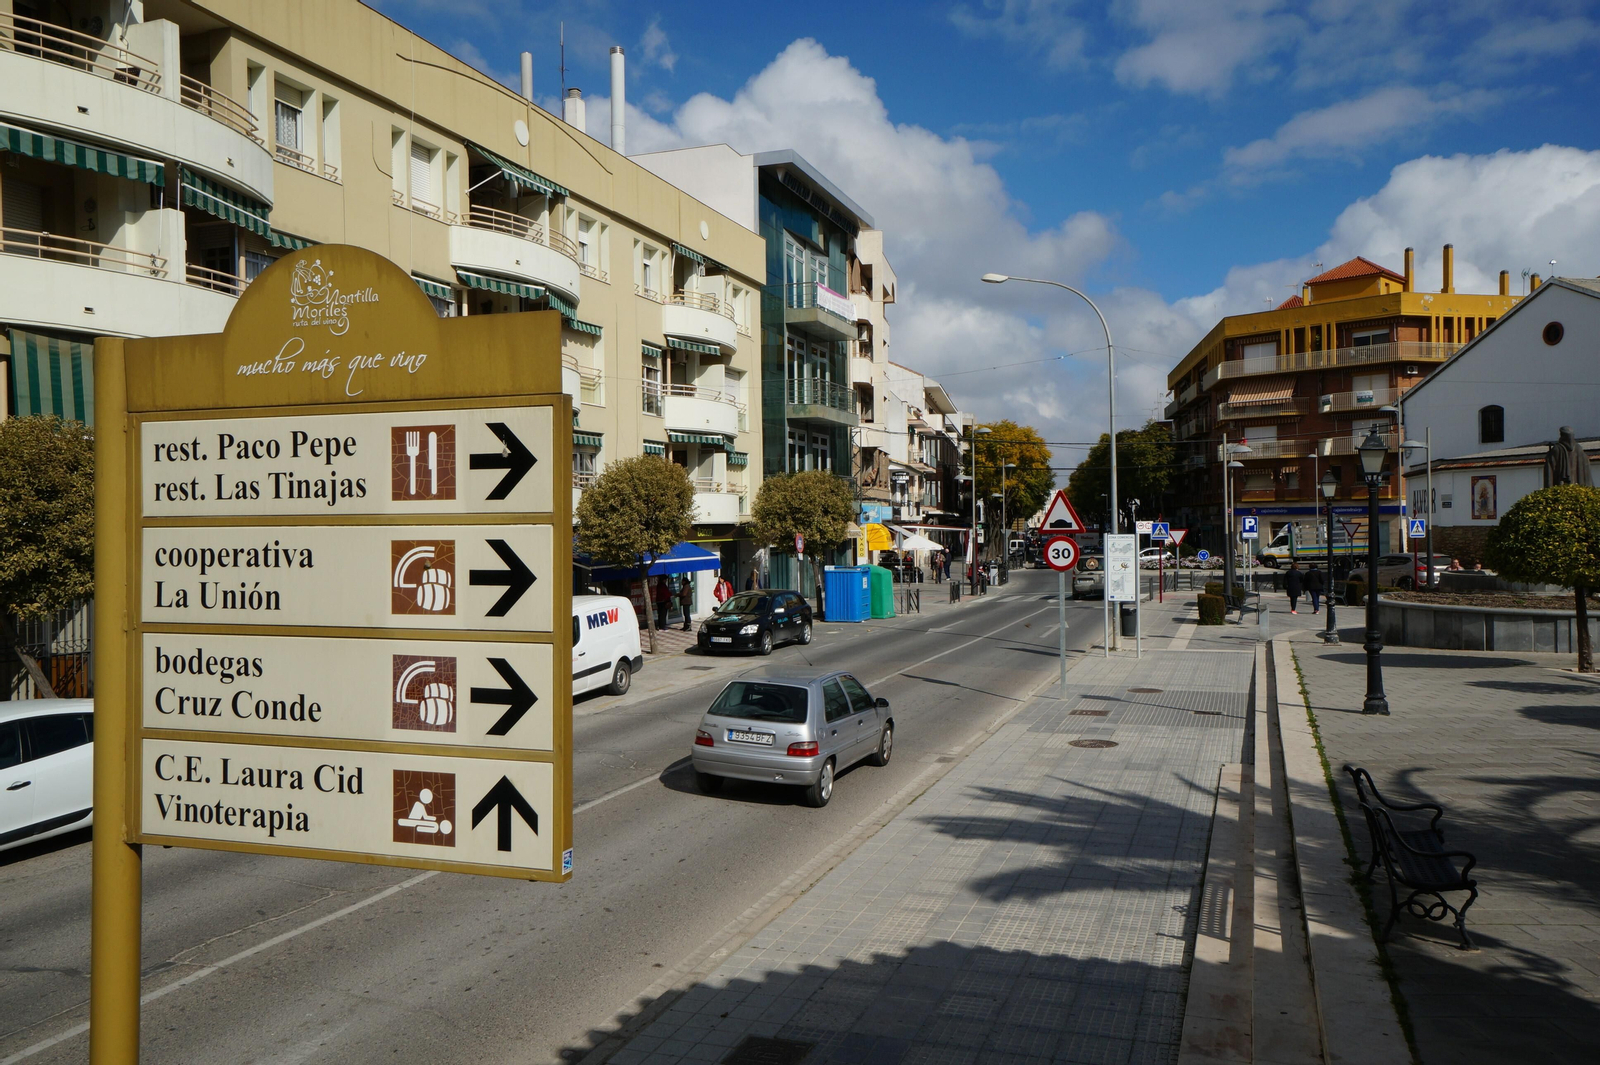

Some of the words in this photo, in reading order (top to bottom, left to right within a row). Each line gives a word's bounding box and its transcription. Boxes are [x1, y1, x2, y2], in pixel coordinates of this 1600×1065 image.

[325, 287, 380, 306] Montilla
[291, 302, 349, 326] Moriles
[292, 319, 308, 327] ruta
[310, 317, 321, 326] del
[236, 336, 305, 377] mucho
[301, 349, 341, 379] más
[345, 353, 385, 397] que
[389, 351, 428, 374] vino
[153, 436, 208, 462] rest.
[216, 433, 281, 460] Paco
[289, 430, 357, 465] Pepe
[153, 476, 206, 501] rest.
[214, 473, 260, 500] Las
[267, 470, 367, 507] Tinajas
[1412, 487, 1437, 514] ALVER
[154, 539, 315, 576] cooperativa
[1051, 547, 1072, 560] 30
[153, 580, 190, 608] La
[198, 581, 282, 610] Unión
[586, 607, 619, 630] MRW
[154, 646, 264, 685] bodegas
[154, 686, 222, 717] Cruz
[230, 690, 322, 723] Conde
[735, 731, 755, 742] 9354
[154, 753, 211, 784] C.E.
[219, 757, 304, 790] Laura
[313, 763, 364, 795] Cid
[153, 793, 311, 838] Vinoterapia
